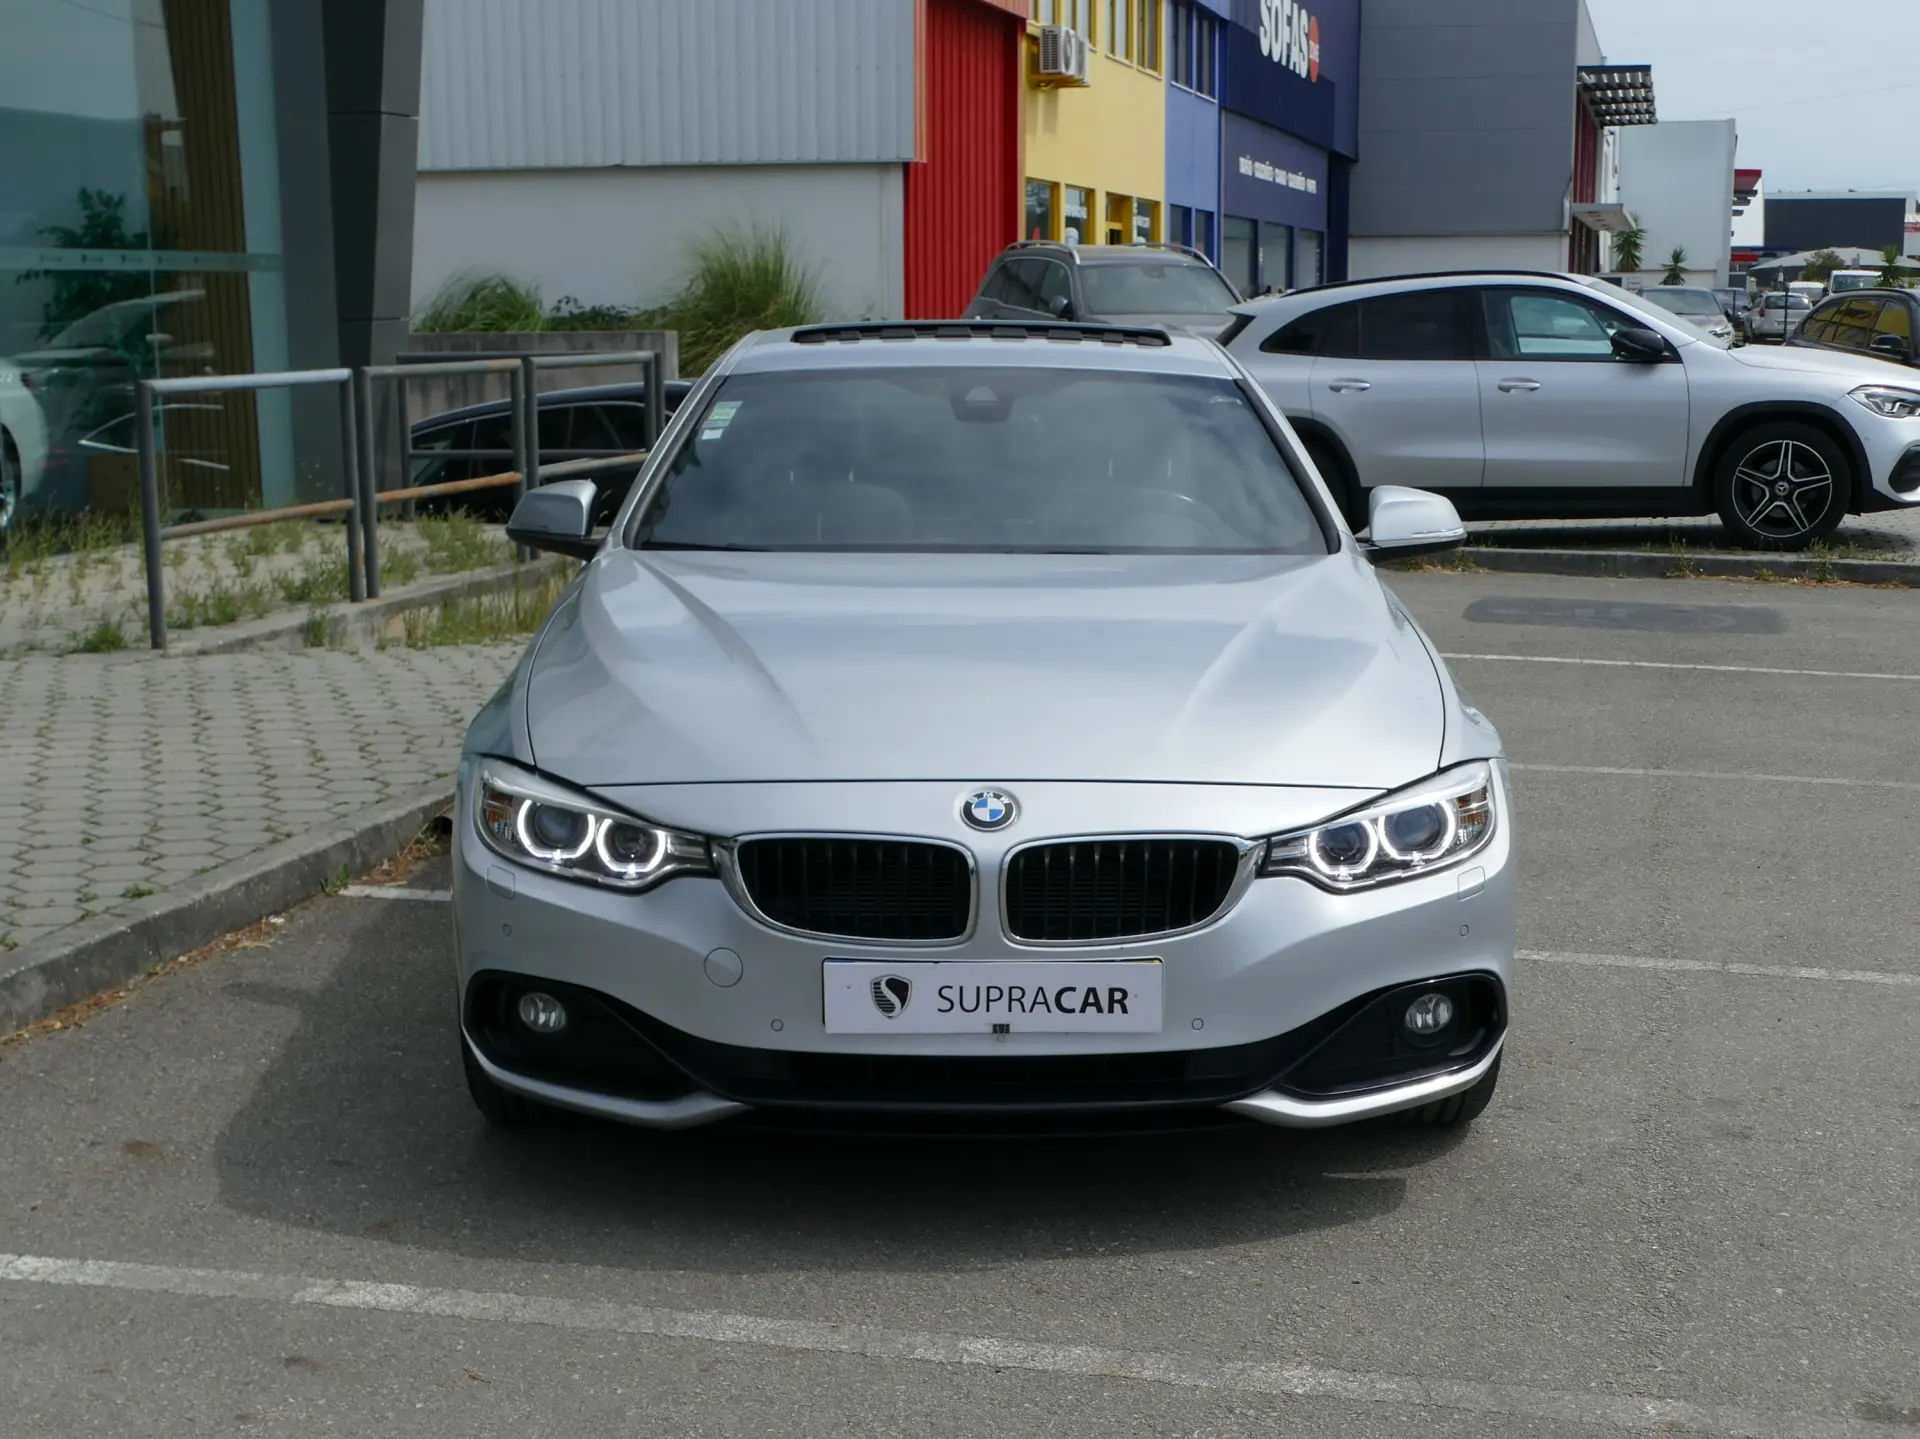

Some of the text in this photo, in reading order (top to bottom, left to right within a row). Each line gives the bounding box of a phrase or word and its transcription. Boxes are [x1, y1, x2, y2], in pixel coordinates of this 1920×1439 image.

[1259, 0, 1309, 79] SOFAS
[969, 791, 1011, 804] BMW
[937, 985, 1130, 1015] SUPRACAR
